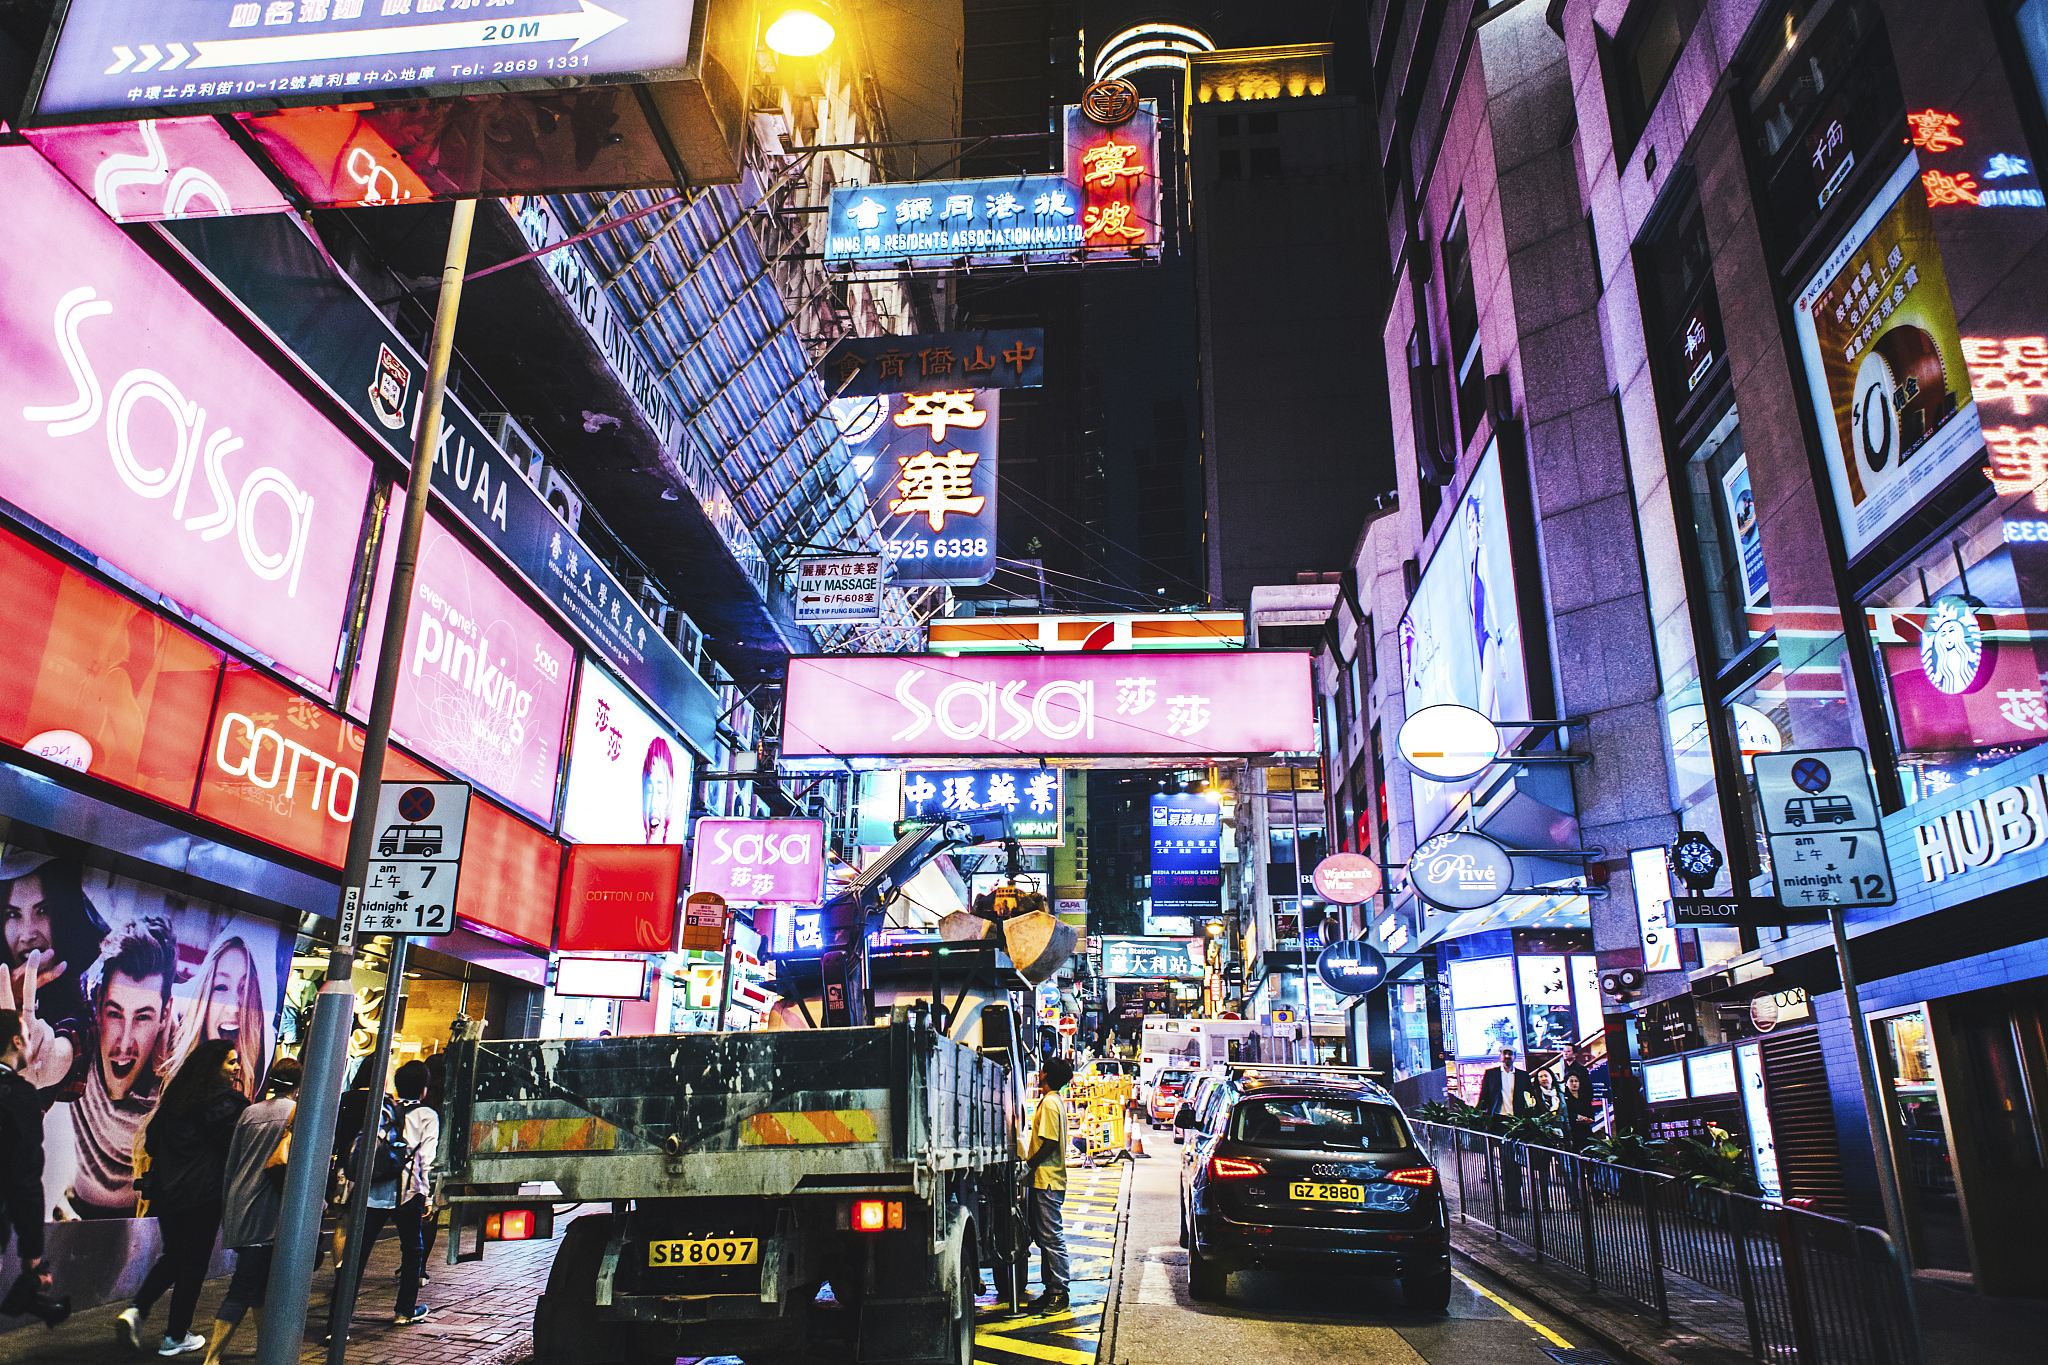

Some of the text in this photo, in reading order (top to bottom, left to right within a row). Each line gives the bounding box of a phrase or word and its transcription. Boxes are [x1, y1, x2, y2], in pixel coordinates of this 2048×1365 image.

[482, 22, 540, 41] 20M
[451, 64, 485, 77] Tel:
[492, 59, 538, 75] 2869
[547, 55, 590, 70] 1331
[832, 238, 861, 254] NING
[864, 235, 880, 252] PO
[884, 232, 949, 252] RESIDENTS
[1808, 278, 1824, 301] NCB
[603, 307, 675, 447] UNIVERSITY
[885, 539, 989, 558] 525 6338
[548, 558, 564, 580] HONG
[563, 573, 578, 595] KONG
[801, 562, 879, 577] 麗麗穴位美容
[800, 578, 877, 592] LILY MASSAGE
[848, 606, 876, 614] BUILDING
[1115, 676, 1211, 737] 莎莎
[1794, 836, 1815, 847] am
[1840, 836, 1858, 860] 7
[1793, 849, 1824, 862] 上午
[379, 865, 397, 873] am
[1322, 868, 1373, 881] Watson's
[1428, 853, 1497, 885] Privé
[369, 874, 401, 889] 上午
[420, 866, 437, 889] 7
[731, 866, 775, 896] 莎莎
[1153, 876, 1167, 885] TEL
[1173, 876, 1195, 885] 2988
[1323, 878, 1354, 890] Wine
[1784, 874, 1843, 887] midnight
[1850, 874, 1886, 899] 12
[586, 891, 655, 902] COTTON ON
[1800, 888, 1834, 902] 午夜
[1059, 901, 1081, 909] CAPA
[1678, 904, 1739, 916] HUBLOT
[364, 915, 395, 929] 午夜
[415, 904, 446, 928] 12
[688, 917, 697, 925] 13
[1109, 948, 1128, 956] Italy
[1109, 954, 1188, 974] 意大利站
[1294, 1184, 1360, 1200] GZ 2880
